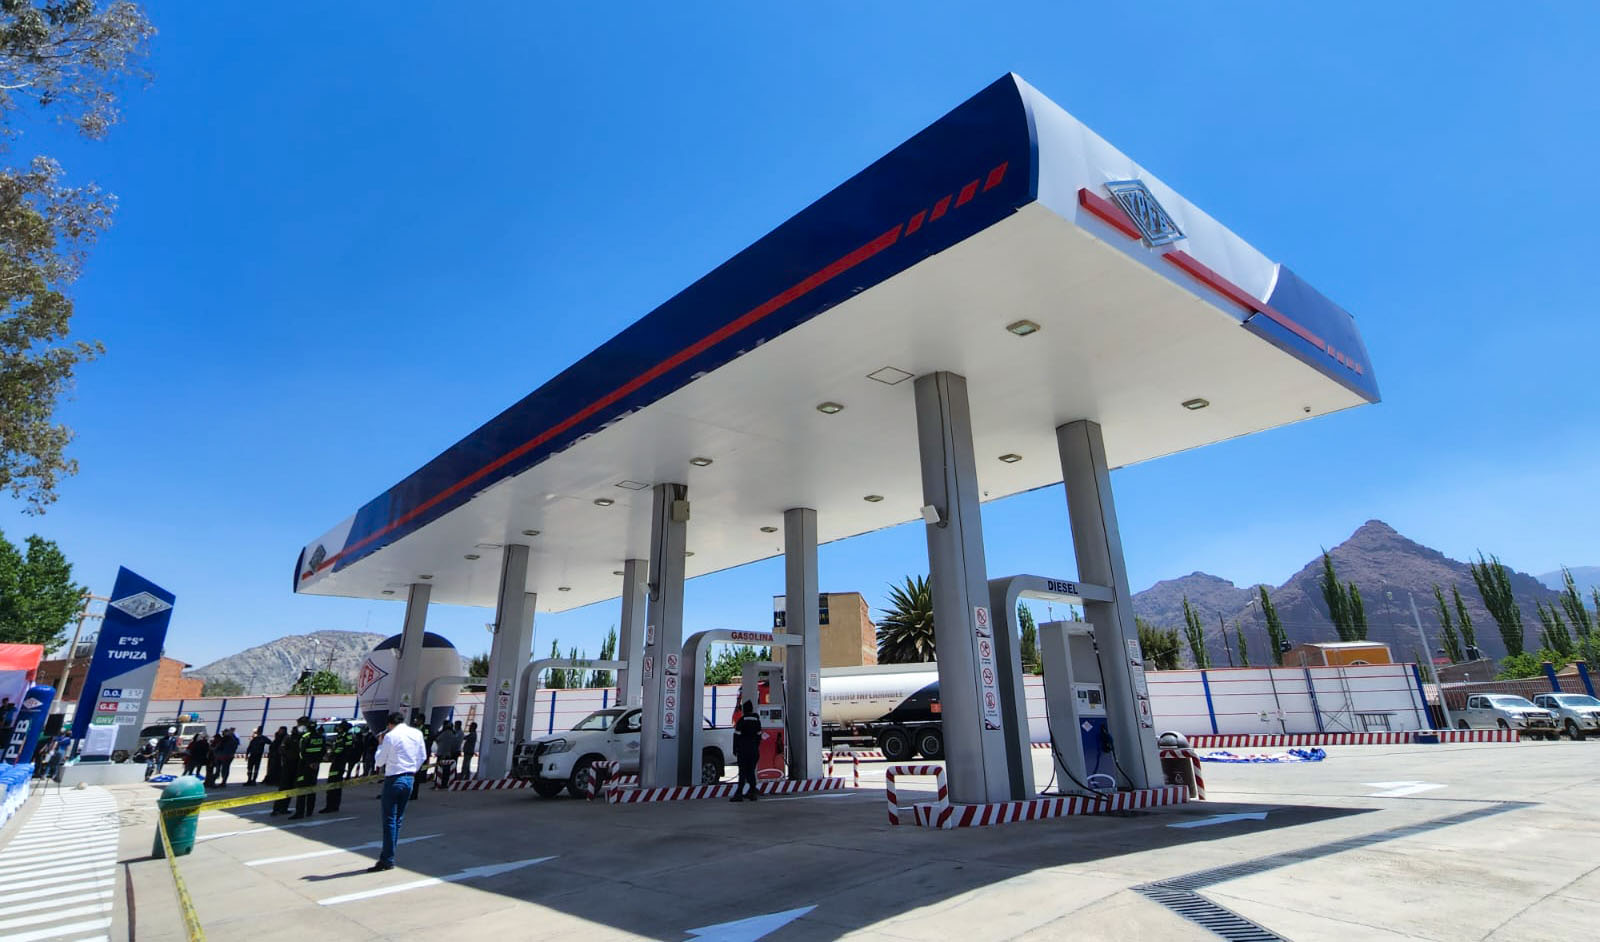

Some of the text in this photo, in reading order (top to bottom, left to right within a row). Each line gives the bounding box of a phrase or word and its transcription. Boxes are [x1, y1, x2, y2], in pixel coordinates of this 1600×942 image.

[1048, 580, 1078, 594] DIESEL
[731, 631, 774, 641] GASOLINA
[108, 650, 147, 660] TUPIZA
